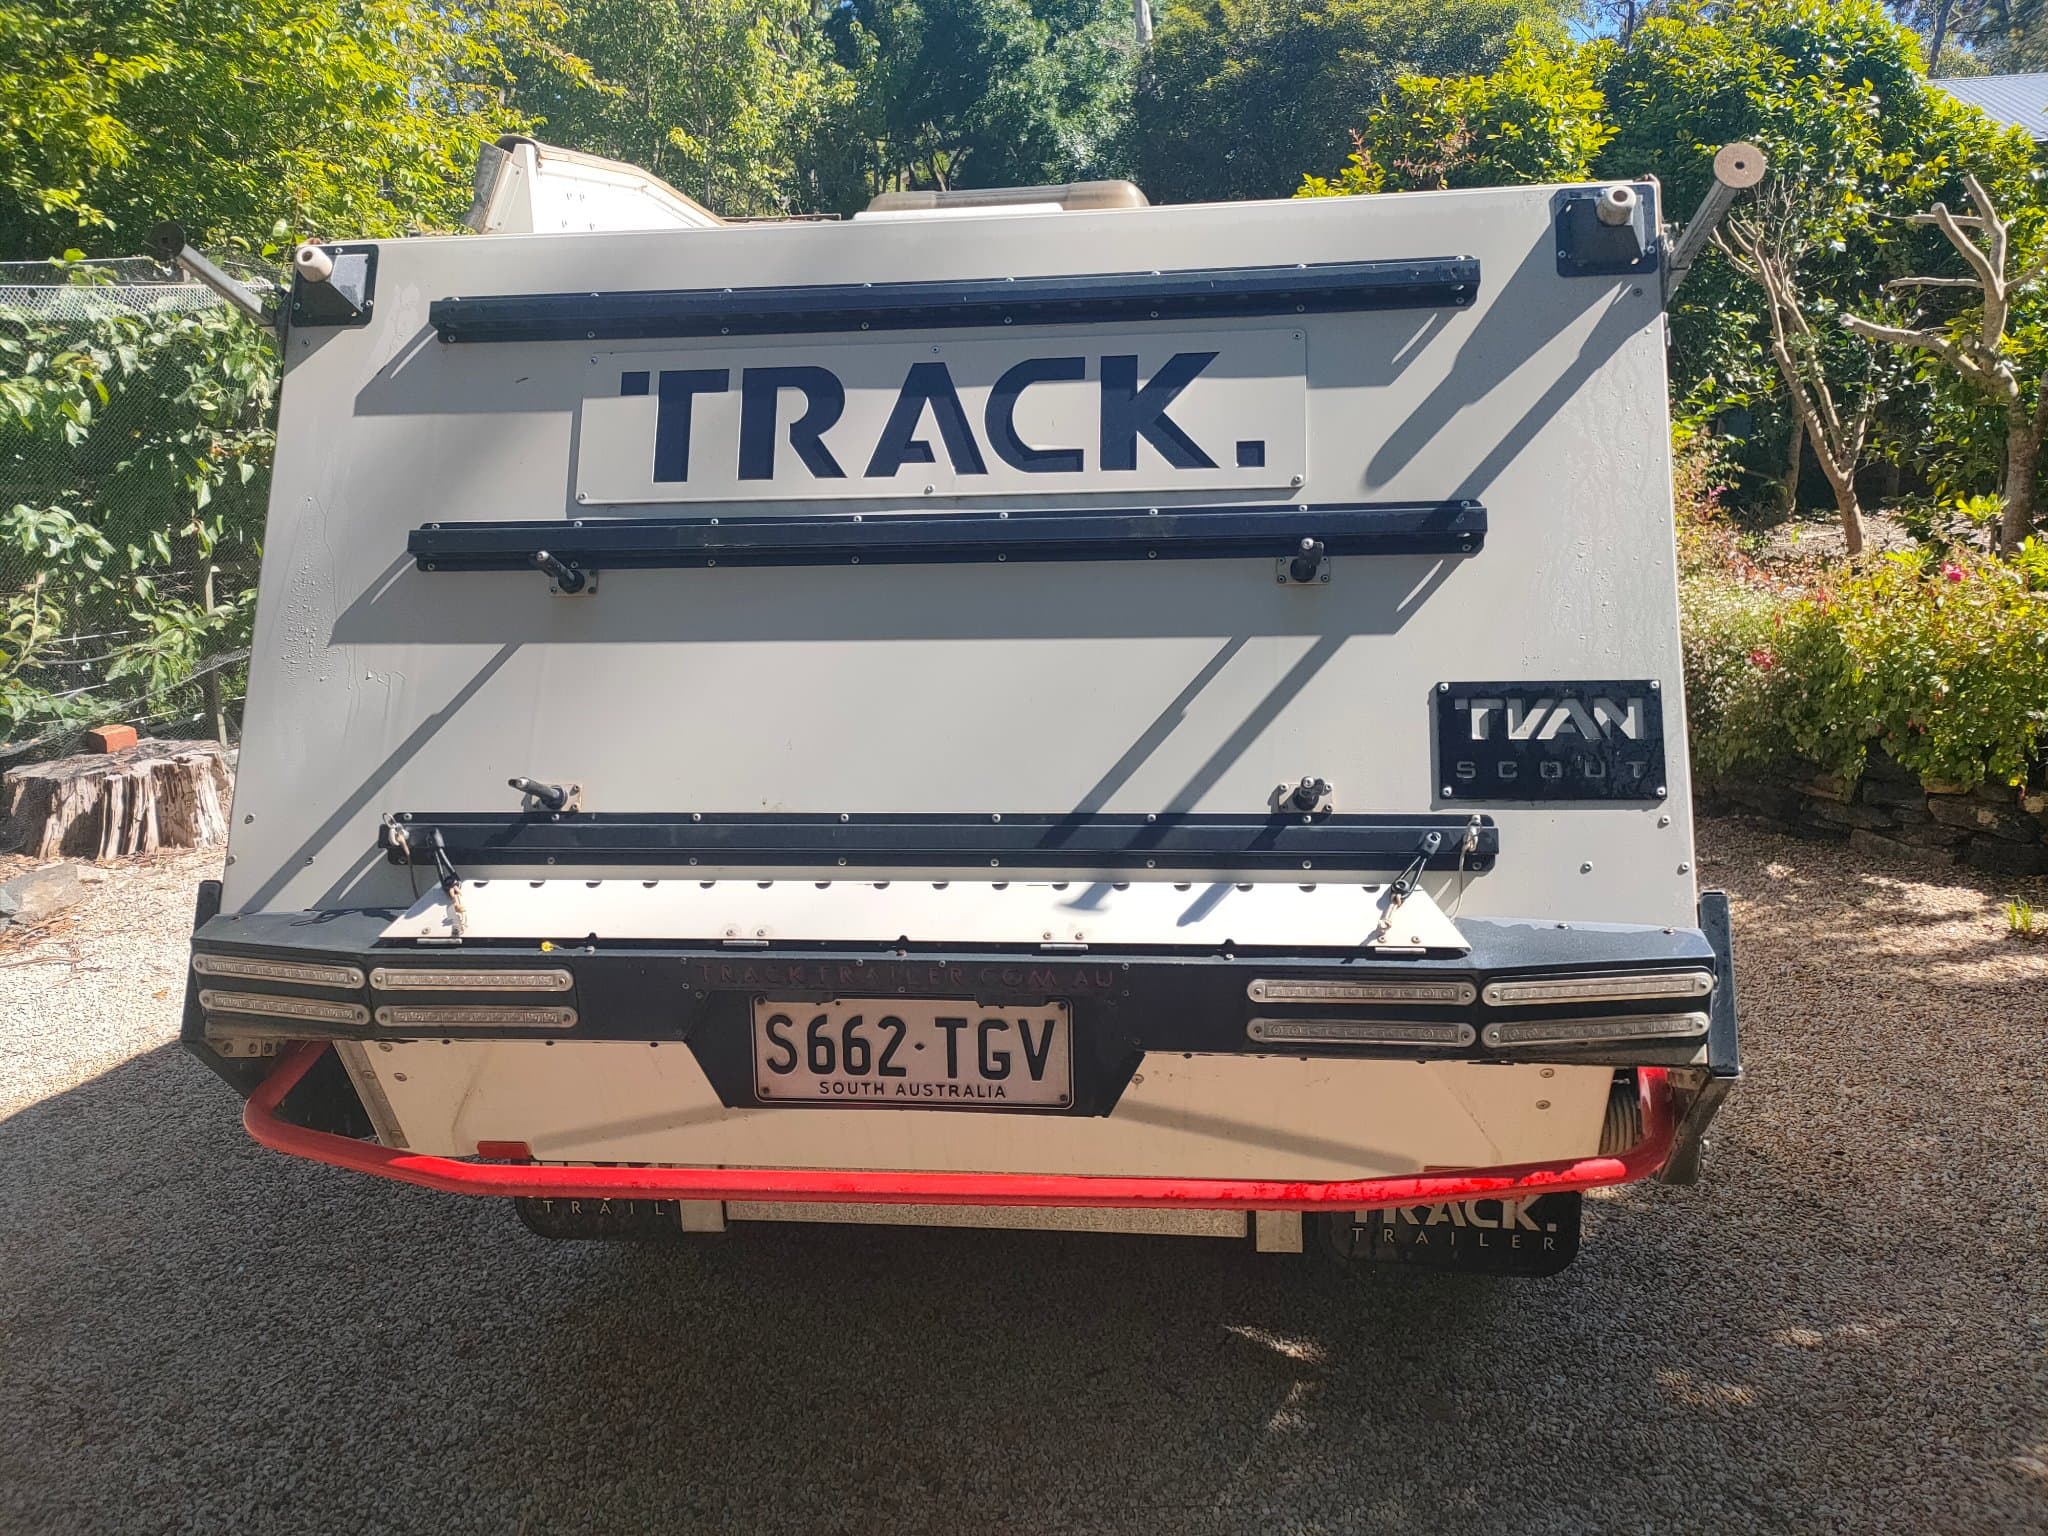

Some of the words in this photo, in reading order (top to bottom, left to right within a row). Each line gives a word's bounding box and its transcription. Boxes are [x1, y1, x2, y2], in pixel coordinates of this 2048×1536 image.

[621, 351, 1266, 484] TRACK.
[1454, 697, 1645, 740] TVAN
[1455, 760, 1648, 779] SCOUT
[819, 1080, 887, 1097] SOUTH
[895, 1082, 1007, 1099] AUSTRALIA
[1351, 1227, 1555, 1251] TRAILER
